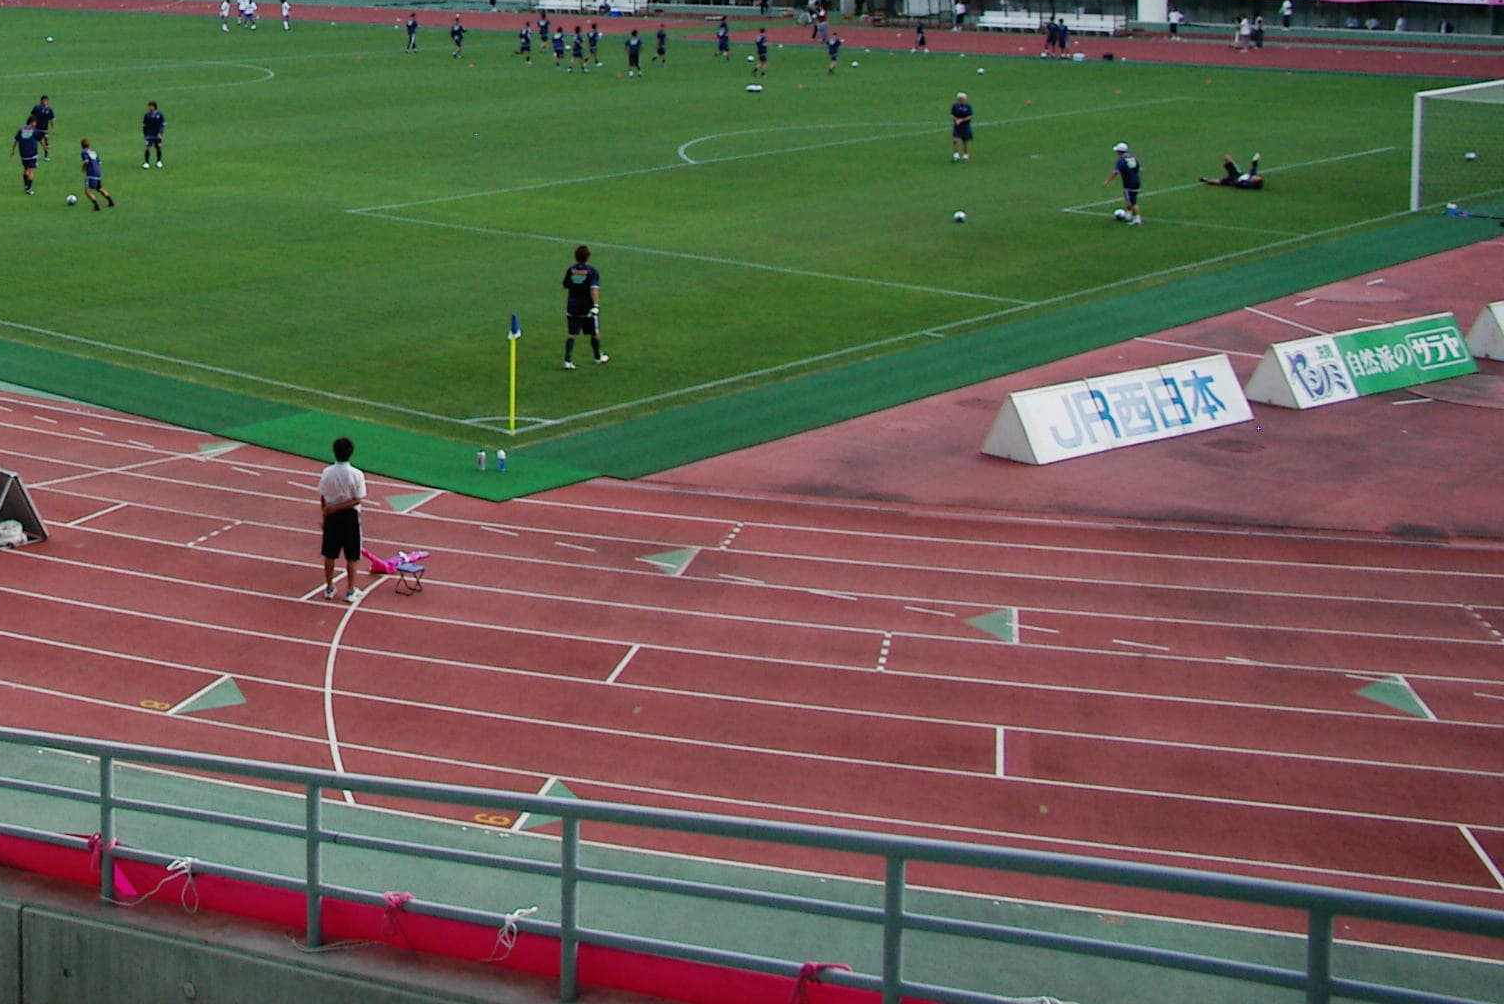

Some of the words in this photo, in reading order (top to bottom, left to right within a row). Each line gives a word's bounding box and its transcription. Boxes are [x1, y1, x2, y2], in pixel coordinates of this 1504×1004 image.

[1345, 343, 1411, 378] 自然派の
[1411, 333, 1462, 365] サラヤ
[1049, 369, 1227, 450] JR西日本
